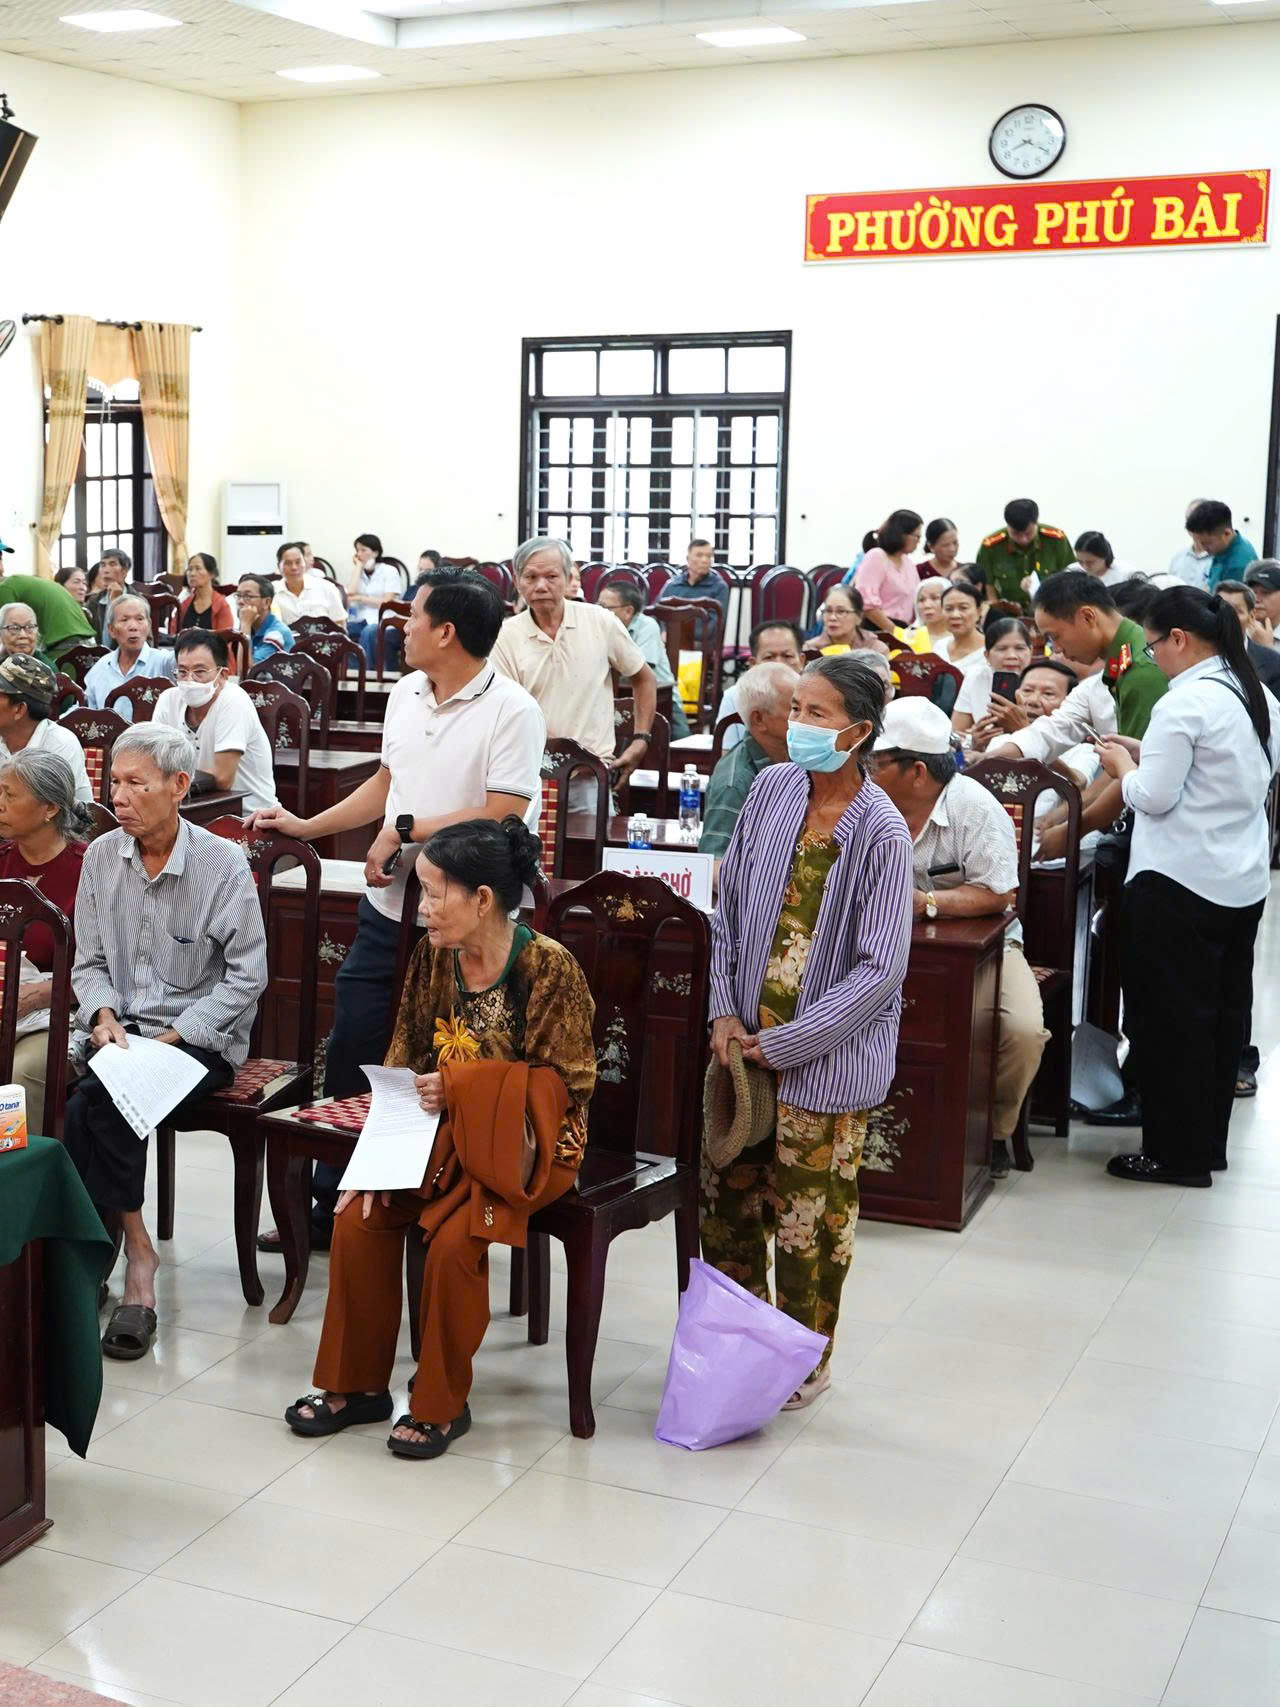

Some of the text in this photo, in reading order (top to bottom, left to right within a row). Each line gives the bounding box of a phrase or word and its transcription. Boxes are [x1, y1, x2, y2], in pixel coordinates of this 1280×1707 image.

[826, 181, 1242, 252] PHƯỜNG PHÚ BÀI
